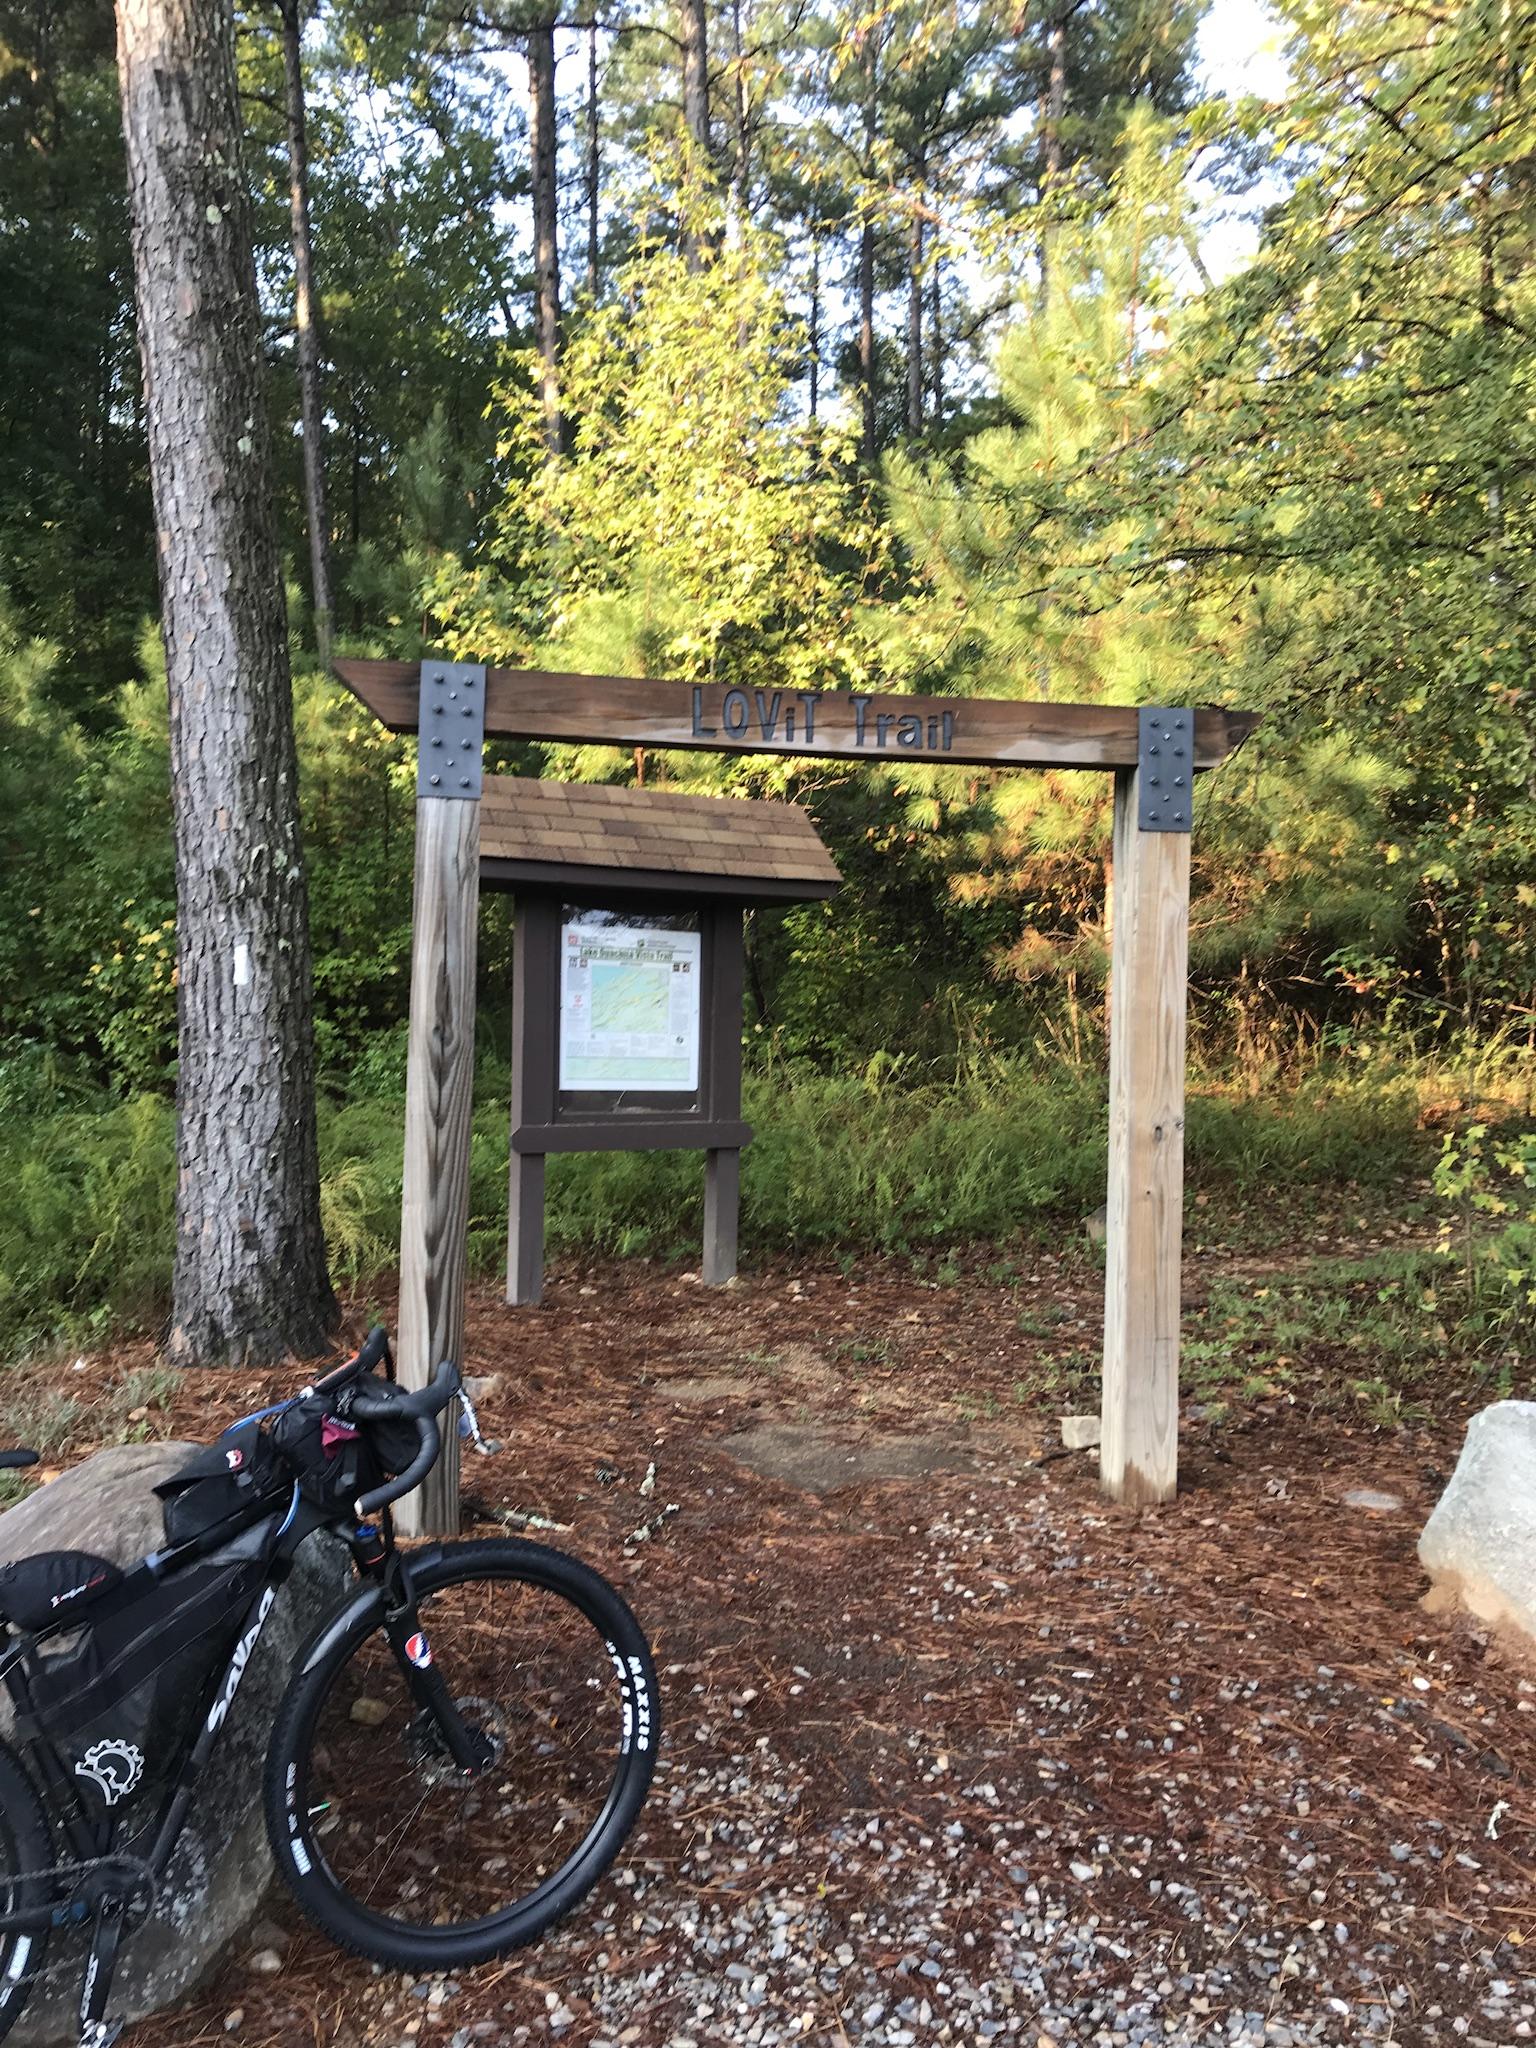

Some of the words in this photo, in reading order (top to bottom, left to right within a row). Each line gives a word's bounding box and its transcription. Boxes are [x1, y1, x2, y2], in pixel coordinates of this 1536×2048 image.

[692, 686, 822, 744] LOViT
[848, 695, 953, 751] Trail
[626, 1655, 650, 1752] MAXXIS
